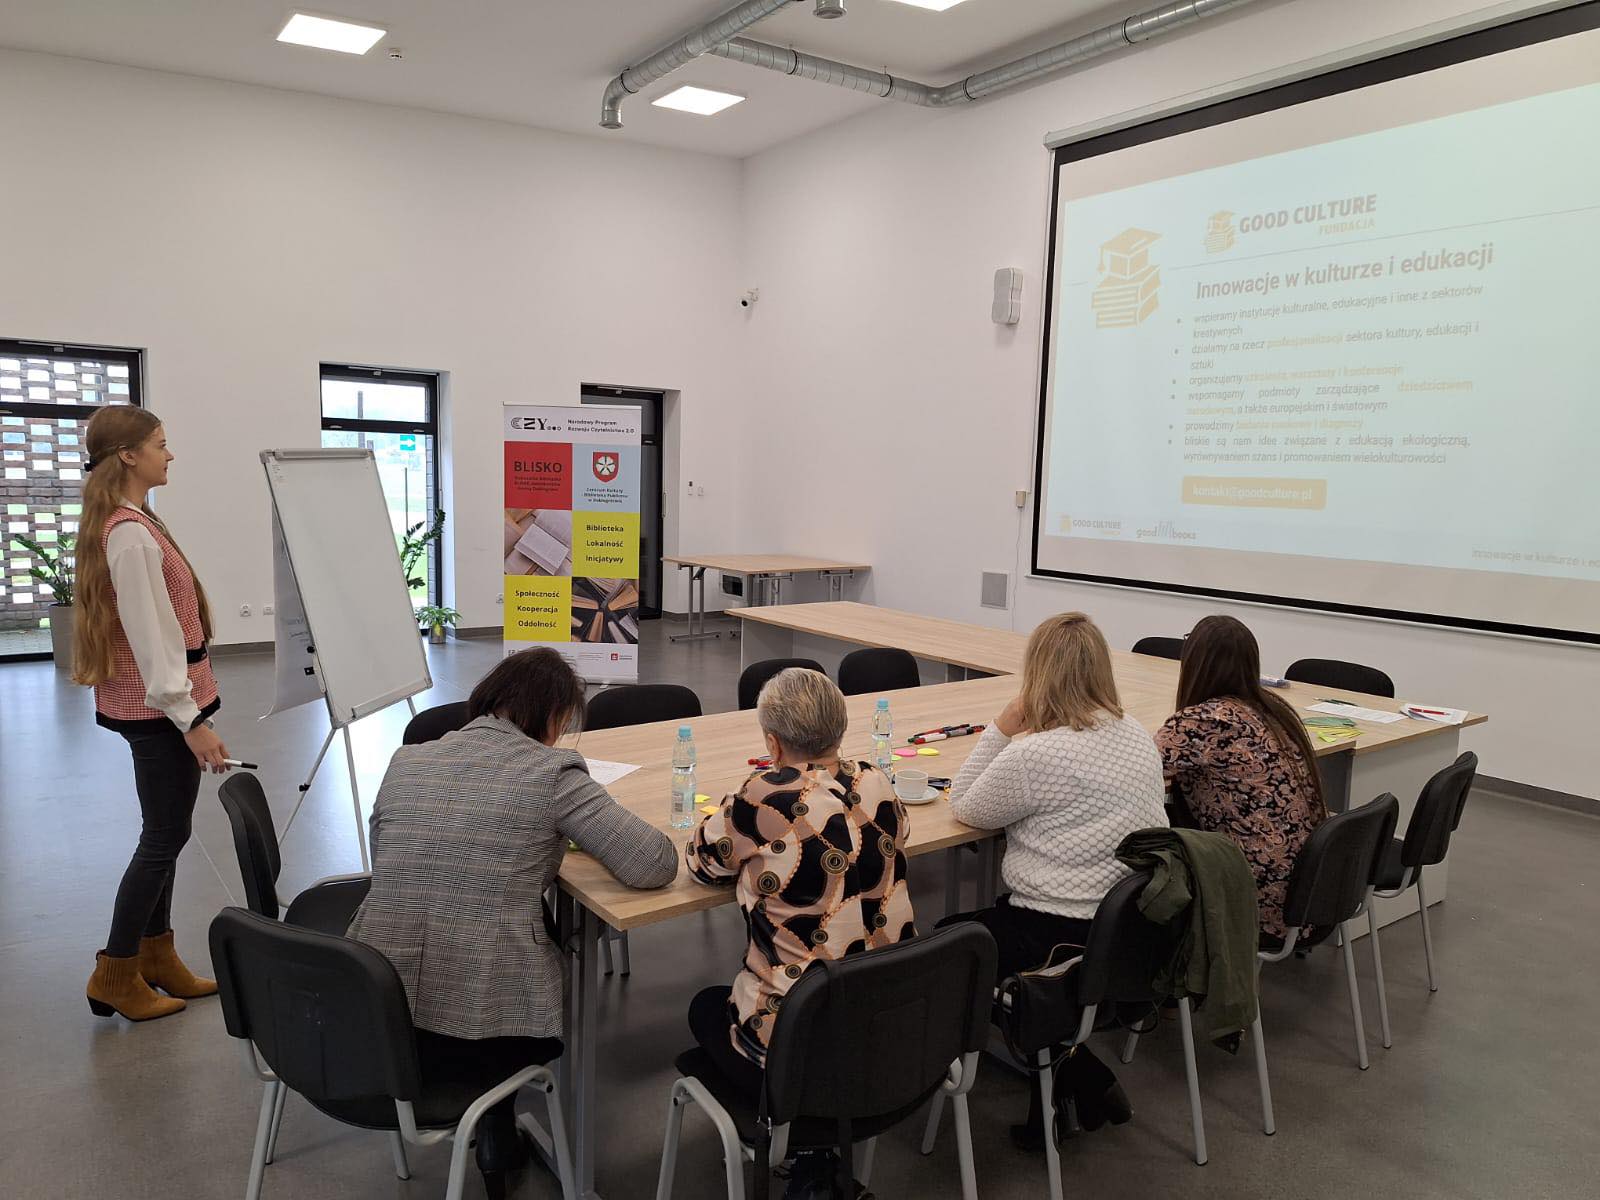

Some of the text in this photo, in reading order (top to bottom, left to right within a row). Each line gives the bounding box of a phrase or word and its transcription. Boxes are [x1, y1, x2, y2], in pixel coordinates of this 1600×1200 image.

[1239, 193, 1377, 235] GOOD CULTURE
[1318, 218, 1376, 235] FUNDACJA
[1196, 242, 1494, 299] Innowacje w kulturze i edukacji
[1239, 305, 1281, 319] instytucje
[1282, 301, 1329, 315] kulturalne,
[1332, 293, 1387, 310] edukacyjne
[1396, 290, 1419, 303] inne
[1431, 284, 1484, 300] sektorów
[1193, 325, 1243, 339] kreatywnych
[1229, 342, 1240, 352] na
[1242, 339, 1265, 351] rzecz
[1345, 329, 1383, 343] sektora
[1385, 326, 1423, 340] kultury,
[1425, 320, 1472, 337] edukacji
[1190, 358, 1214, 371] sztuki
[1188, 388, 1245, 402] wspomagamy
[1258, 385, 1301, 399] podmioty
[1315, 383, 1381, 397] zarządzające
[1245, 403, 1268, 415] także
[1269, 402, 1325, 416] europejskim
[1332, 400, 1389, 413] światowym
[1185, 419, 1234, 433] prowadzimy
[1184, 435, 1210, 447] bliskie
[1216, 437, 1226, 448] są
[1233, 437, 1252, 447] nam
[1284, 436, 1328, 448] związane
[1348, 434, 1394, 448] edukacją
[1401, 434, 1471, 448] ekologiczną,
[1251, 453, 1277, 463] szans
[1283, 453, 1351, 464] promowaniem
[1352, 451, 1447, 465] wielokulturowości
[514, 461, 562, 473] BLISKO
[586, 524, 624, 533] Biblioteka
[1072, 519, 1091, 529] GOOD
[586, 539, 624, 548] Lokalność
[586, 554, 624, 564] Inicjatywy
[515, 589, 560, 599] Społeczność
[517, 605, 558, 614] Kooperacja
[518, 620, 557, 629] Oddolność
